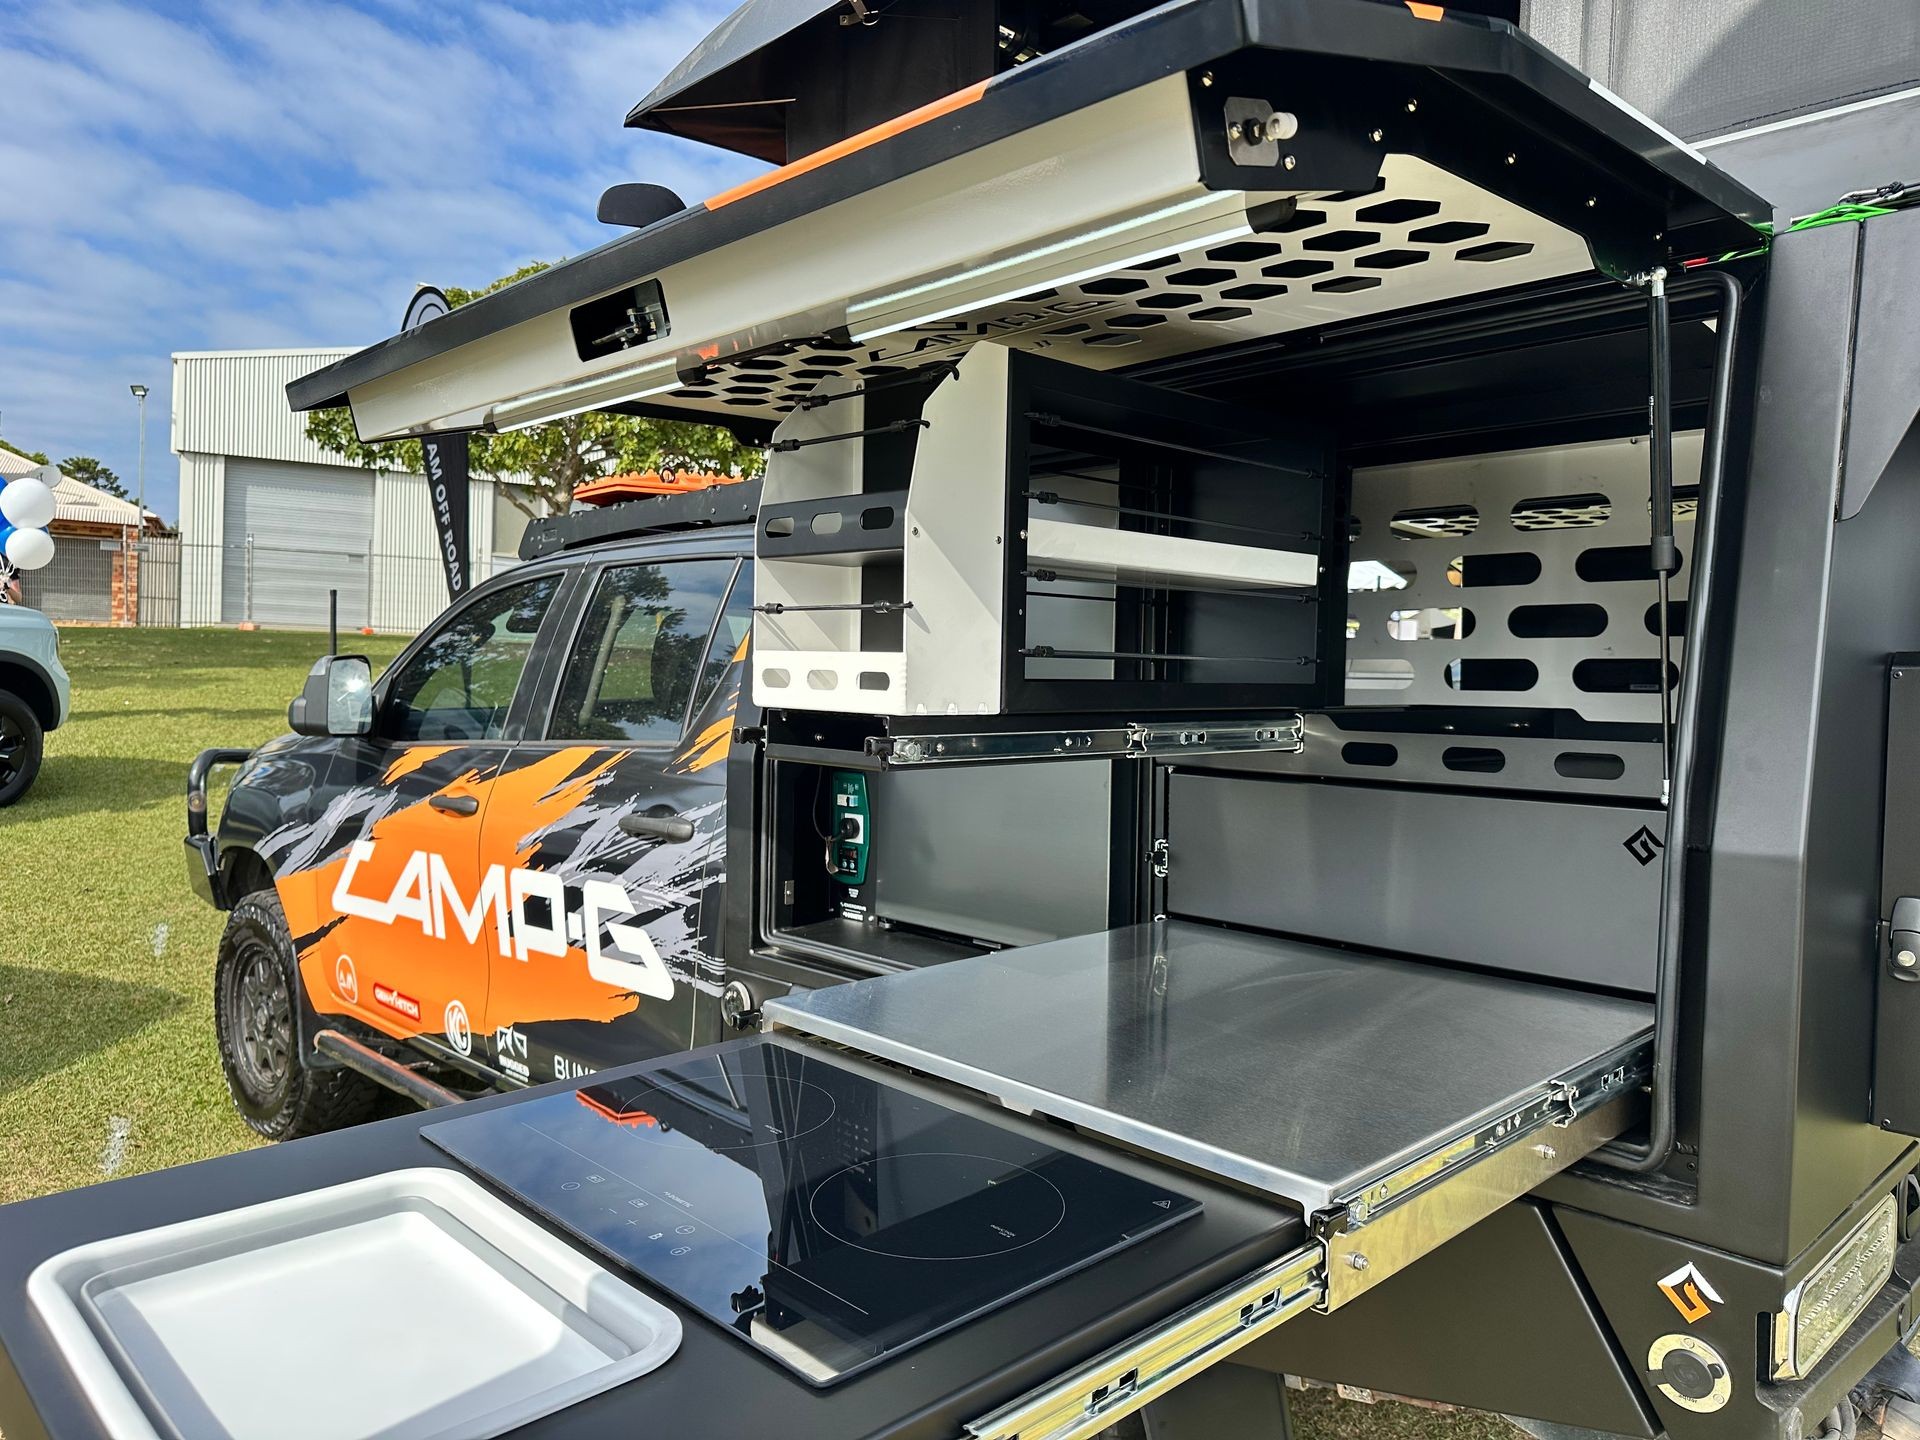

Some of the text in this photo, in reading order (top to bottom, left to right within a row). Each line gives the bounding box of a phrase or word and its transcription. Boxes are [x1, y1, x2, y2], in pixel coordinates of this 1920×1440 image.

[435, 483, 451, 526] OFF
[444, 529, 462, 592] ROAD
[448, 1006, 468, 1049] KC
